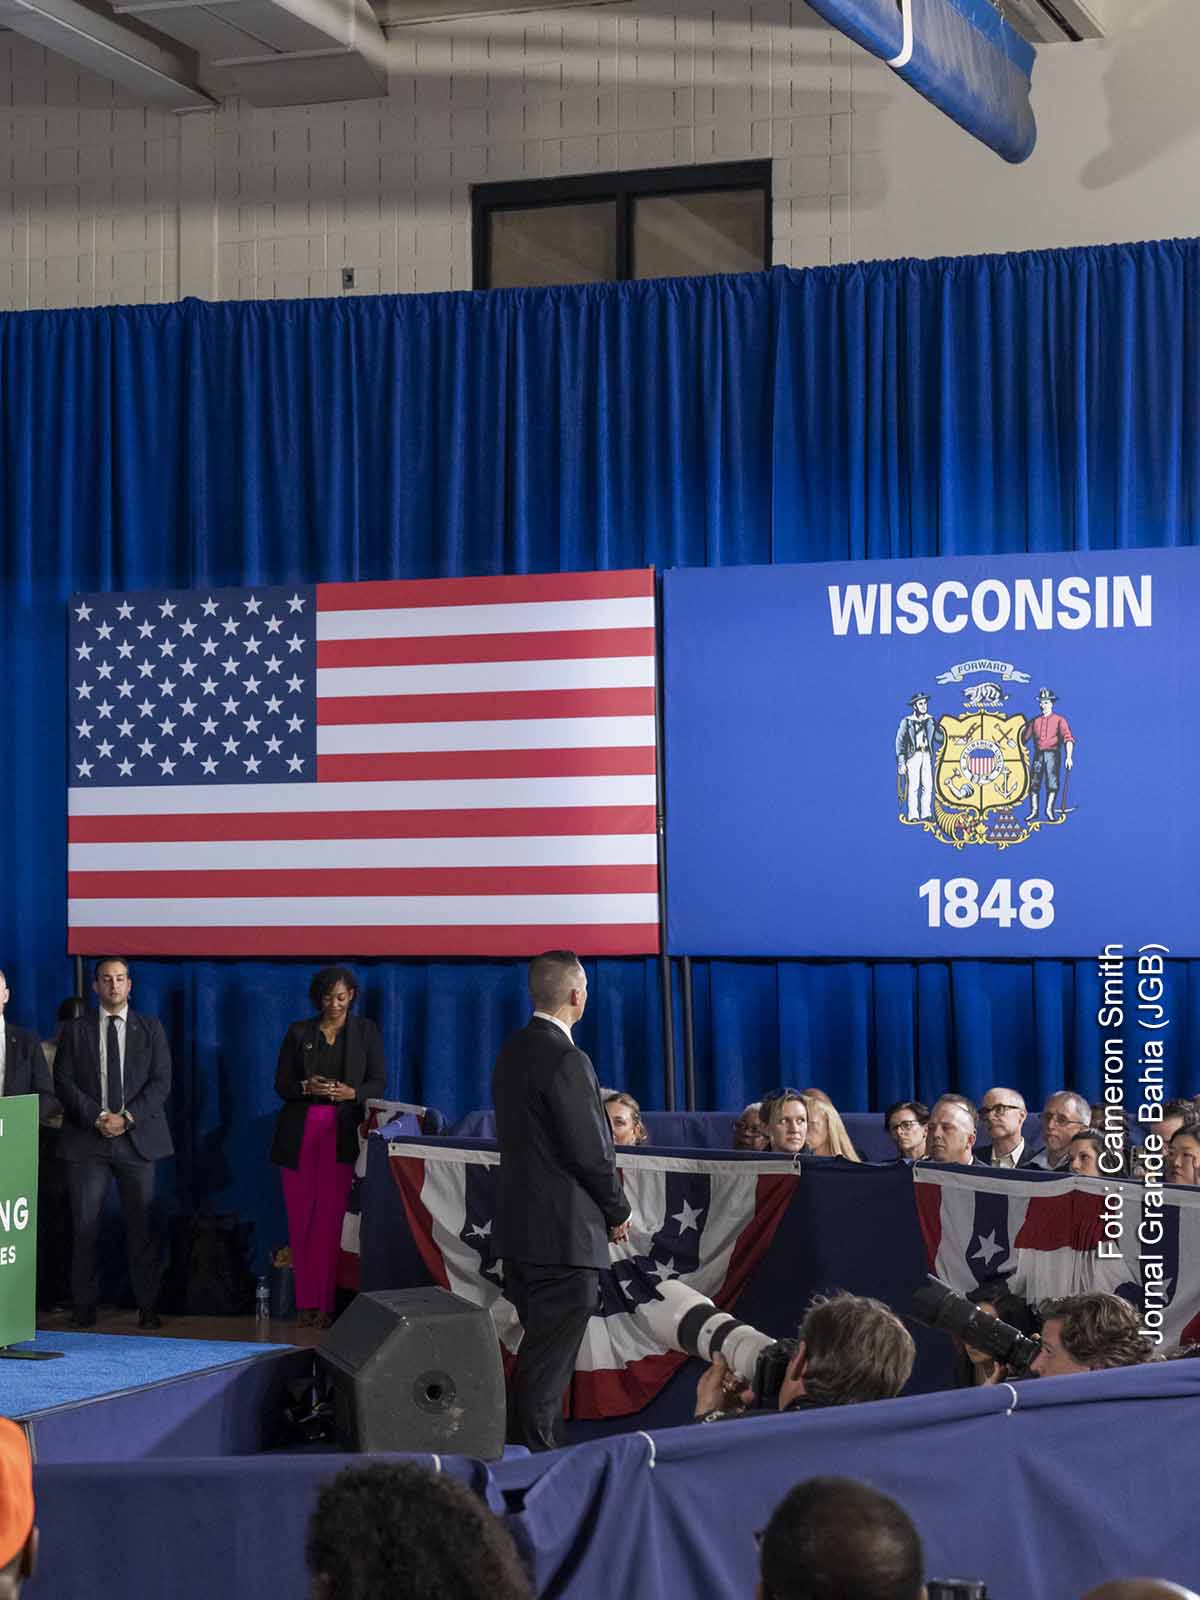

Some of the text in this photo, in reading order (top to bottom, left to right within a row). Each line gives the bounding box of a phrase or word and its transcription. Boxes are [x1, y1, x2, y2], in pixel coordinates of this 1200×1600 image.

[828, 575, 1152, 636] WISCONSIN
[957, 661, 1008, 673] FORWARD
[919, 877, 1055, 930] 1848
